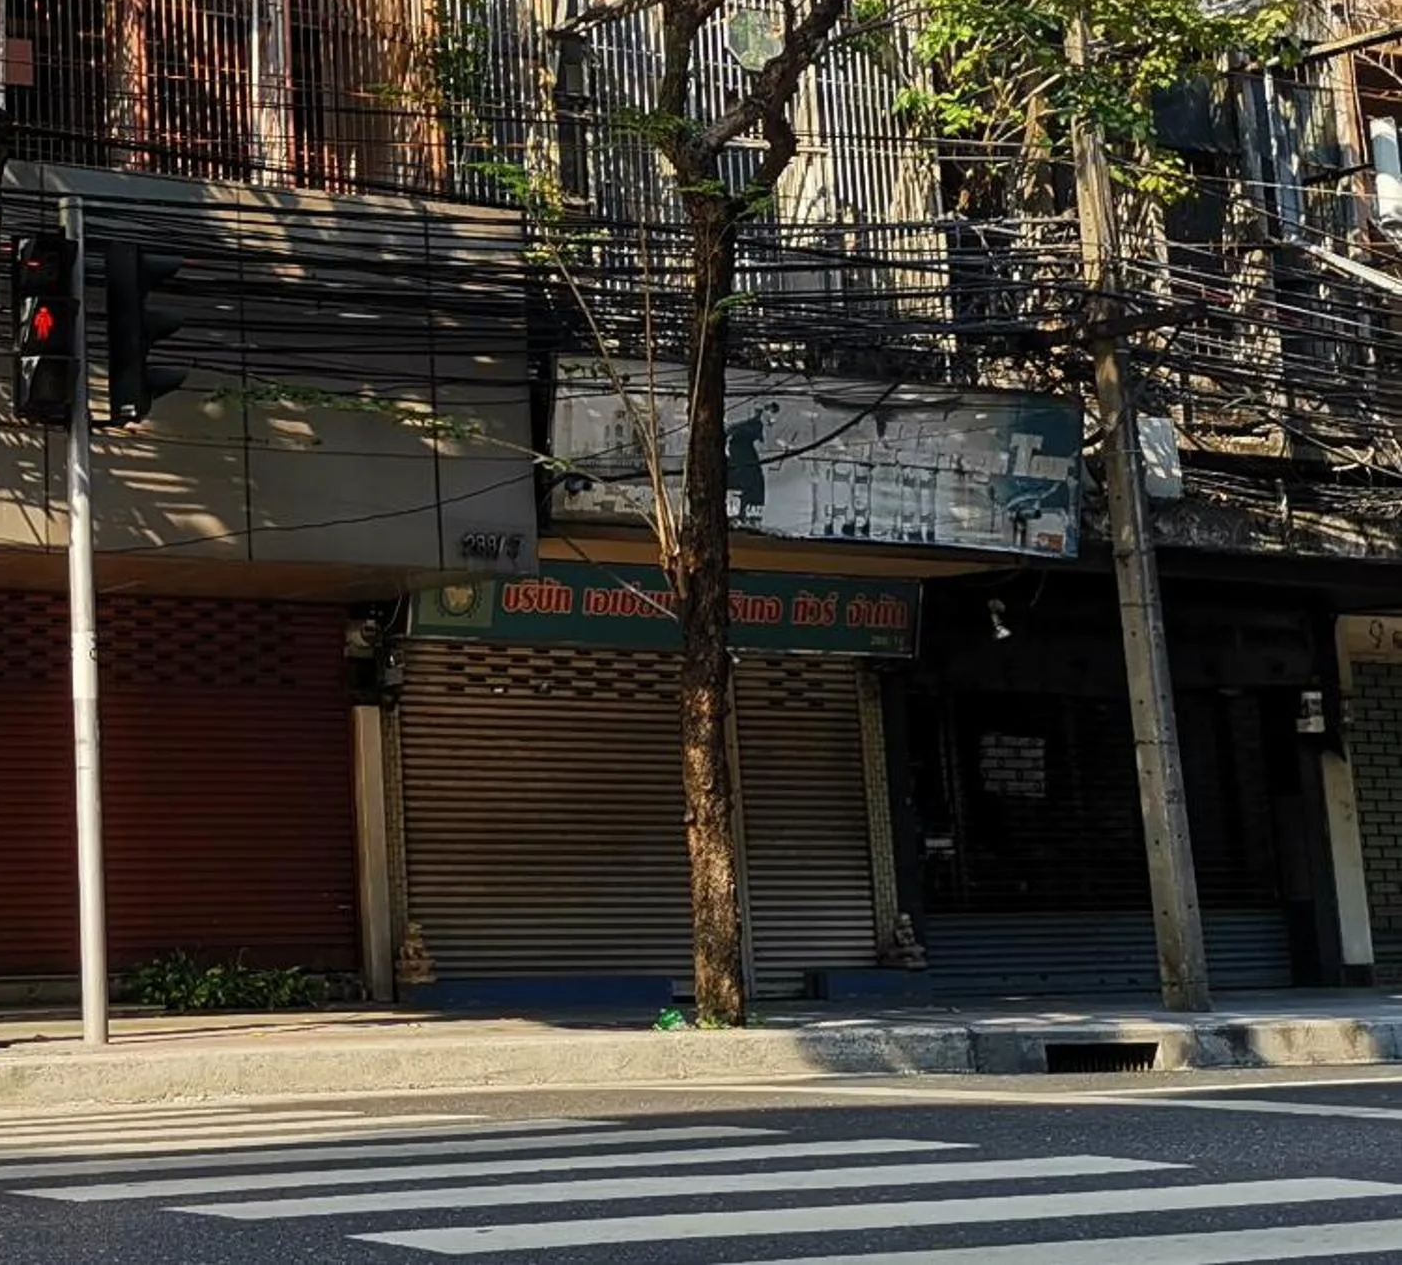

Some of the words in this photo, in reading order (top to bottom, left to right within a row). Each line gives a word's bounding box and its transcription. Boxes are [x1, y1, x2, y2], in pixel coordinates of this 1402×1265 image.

[502, 577, 573, 613] บริษัท
[791, 591, 838, 626] ทัวร์
[845, 592, 909, 629] จำกัด
